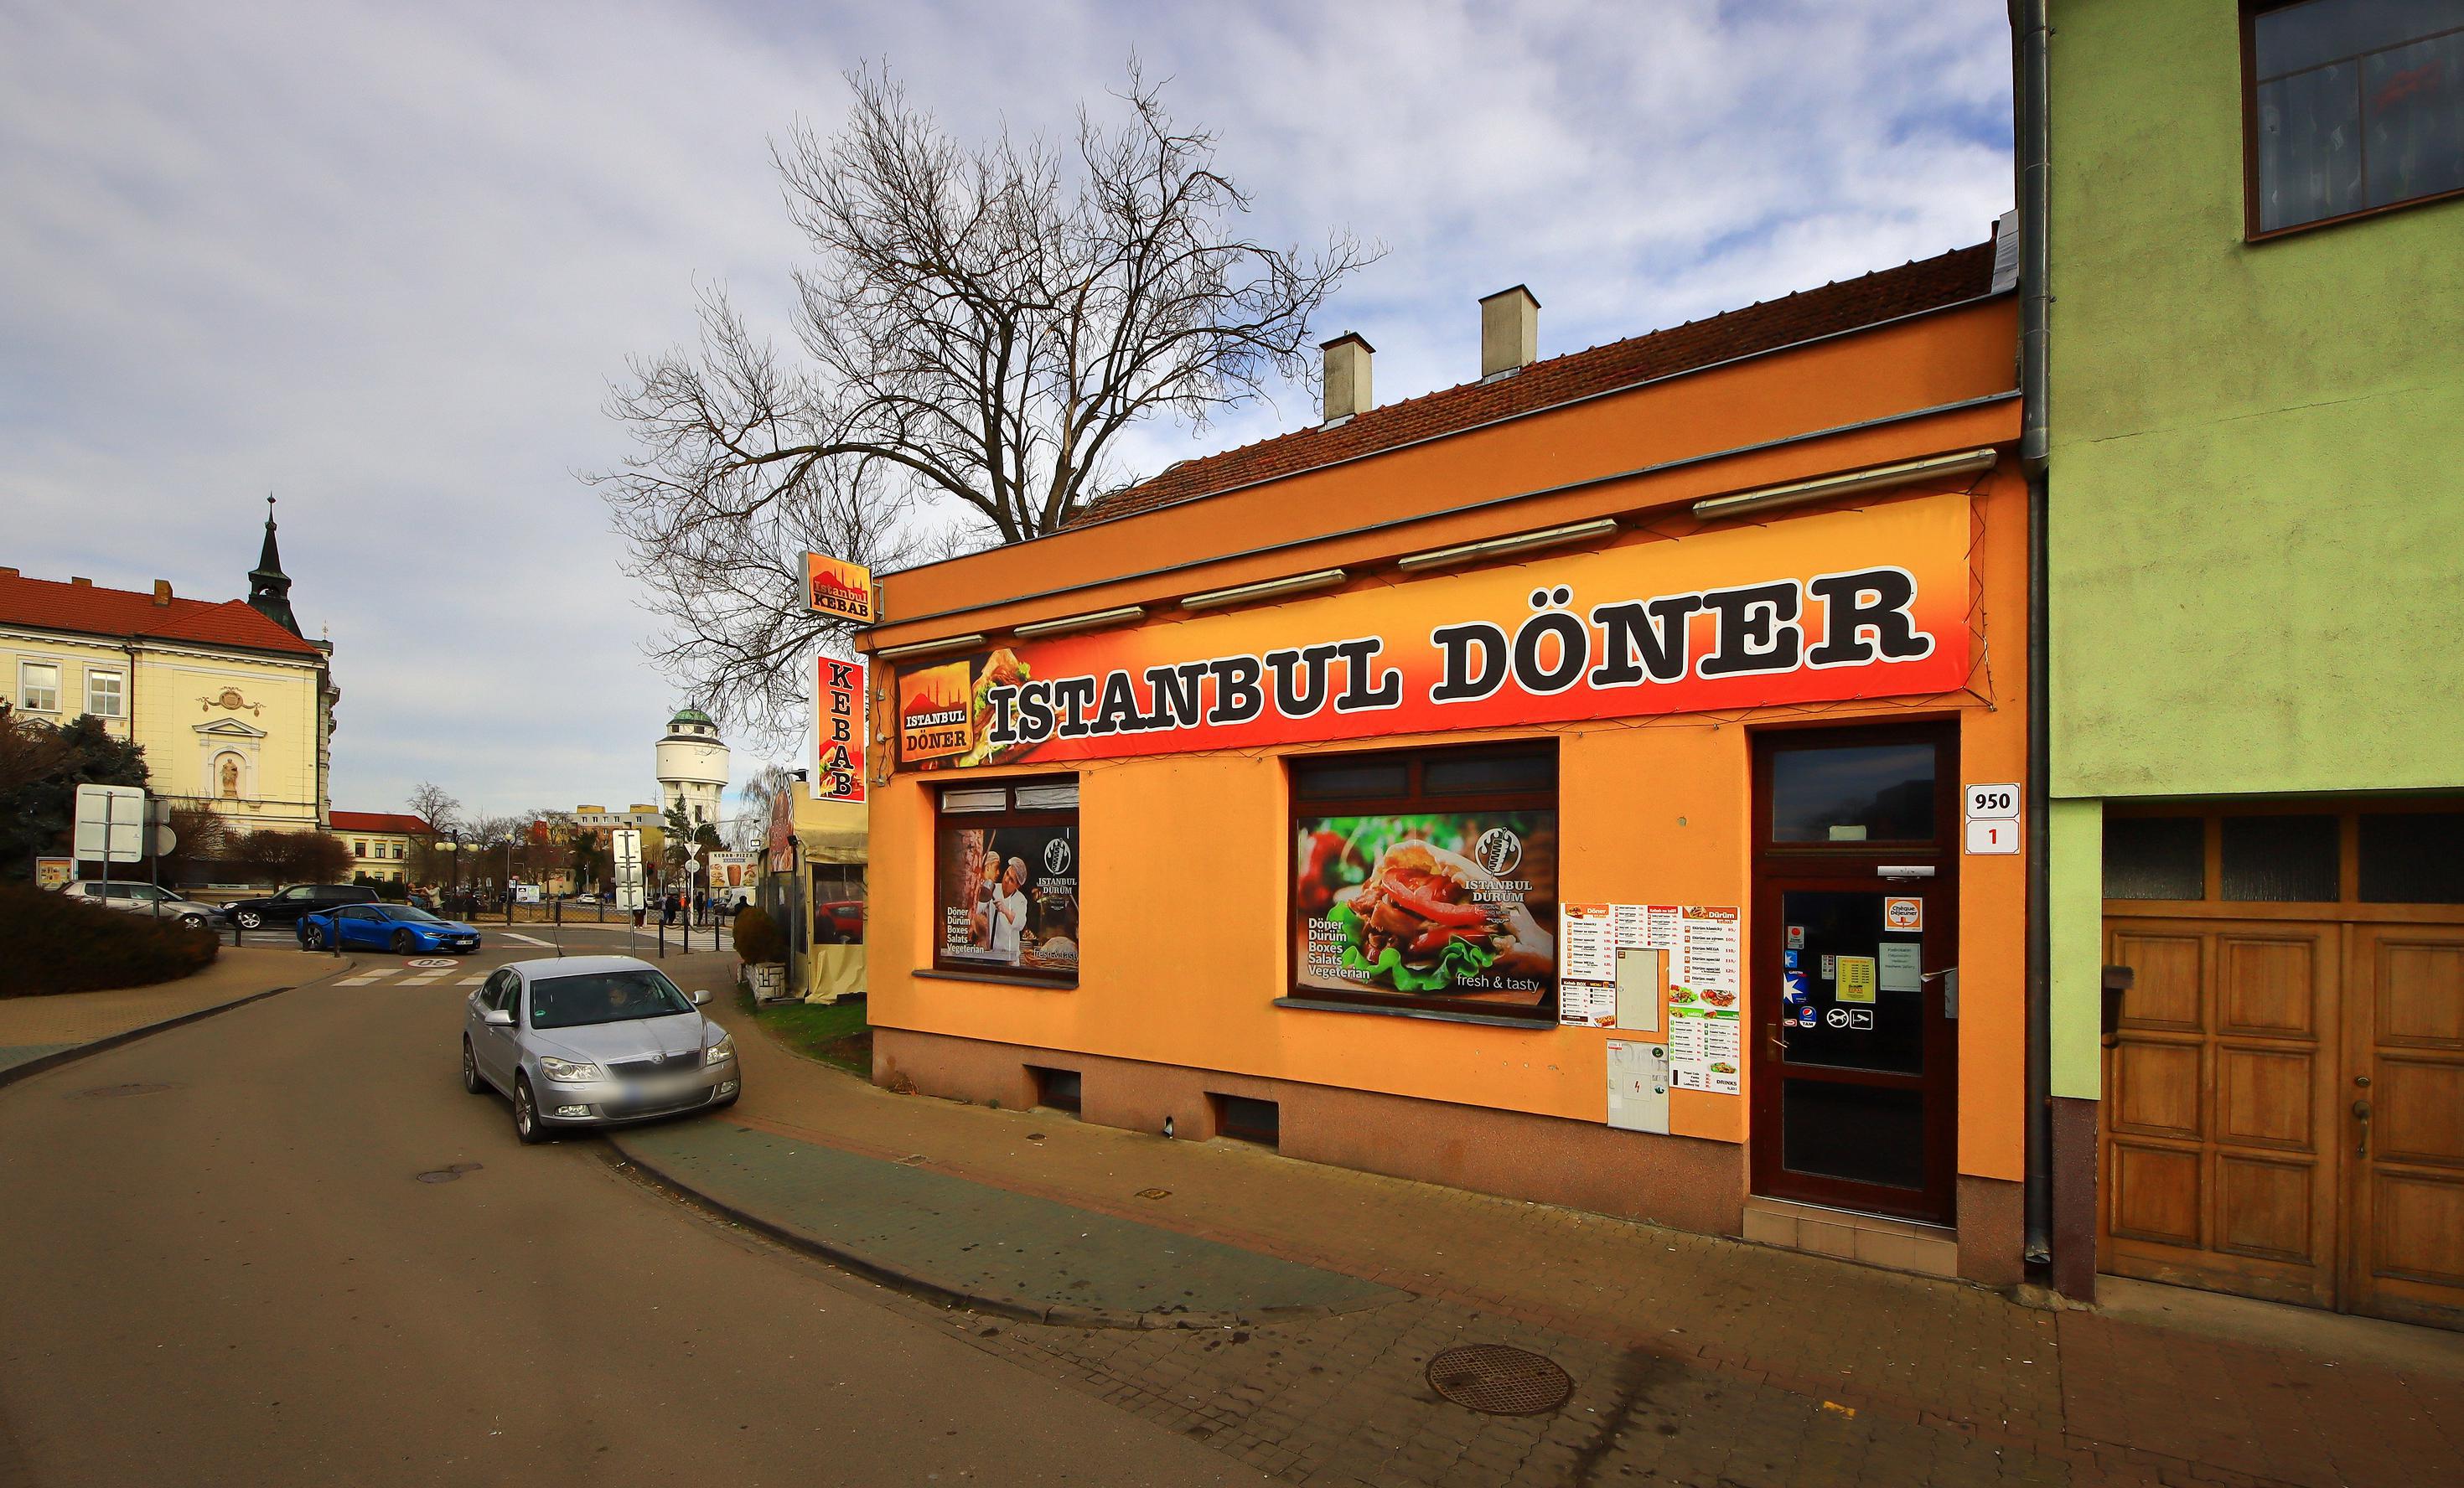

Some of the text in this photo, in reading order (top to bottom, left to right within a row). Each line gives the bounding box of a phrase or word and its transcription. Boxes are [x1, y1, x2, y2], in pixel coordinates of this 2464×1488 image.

[814, 579, 867, 603] Istanbul
[814, 593, 869, 617] KEBAB
[989, 567, 1934, 744] ISTANBUL DÖNER
[906, 710, 965, 727] ISTANBUL
[828, 663, 854, 795] KEBAB
[906, 730, 966, 751] DÖNER
[1975, 793, 2010, 809] 950
[1988, 829, 1996, 844] 1
[1043, 885, 1072, 894] DÜRÜM
[1465, 880, 1533, 890] ISTANBUL
[1473, 890, 1524, 902] DÜRÜM
[947, 907, 968, 916] Döner
[947, 917, 971, 925] Dürüm
[1308, 918, 1343, 930] Döner
[947, 925, 968, 934] Boxes
[947, 935, 968, 943] Salats
[1308, 930, 1347, 942] Dürüm
[947, 943, 984, 954] Vegeterian
[1308, 942, 1343, 954] Boxes
[1308, 953, 1343, 966] Salats
[1308, 964, 1371, 979] Vegeterian
[1456, 973, 1540, 993] fresh & tasty
